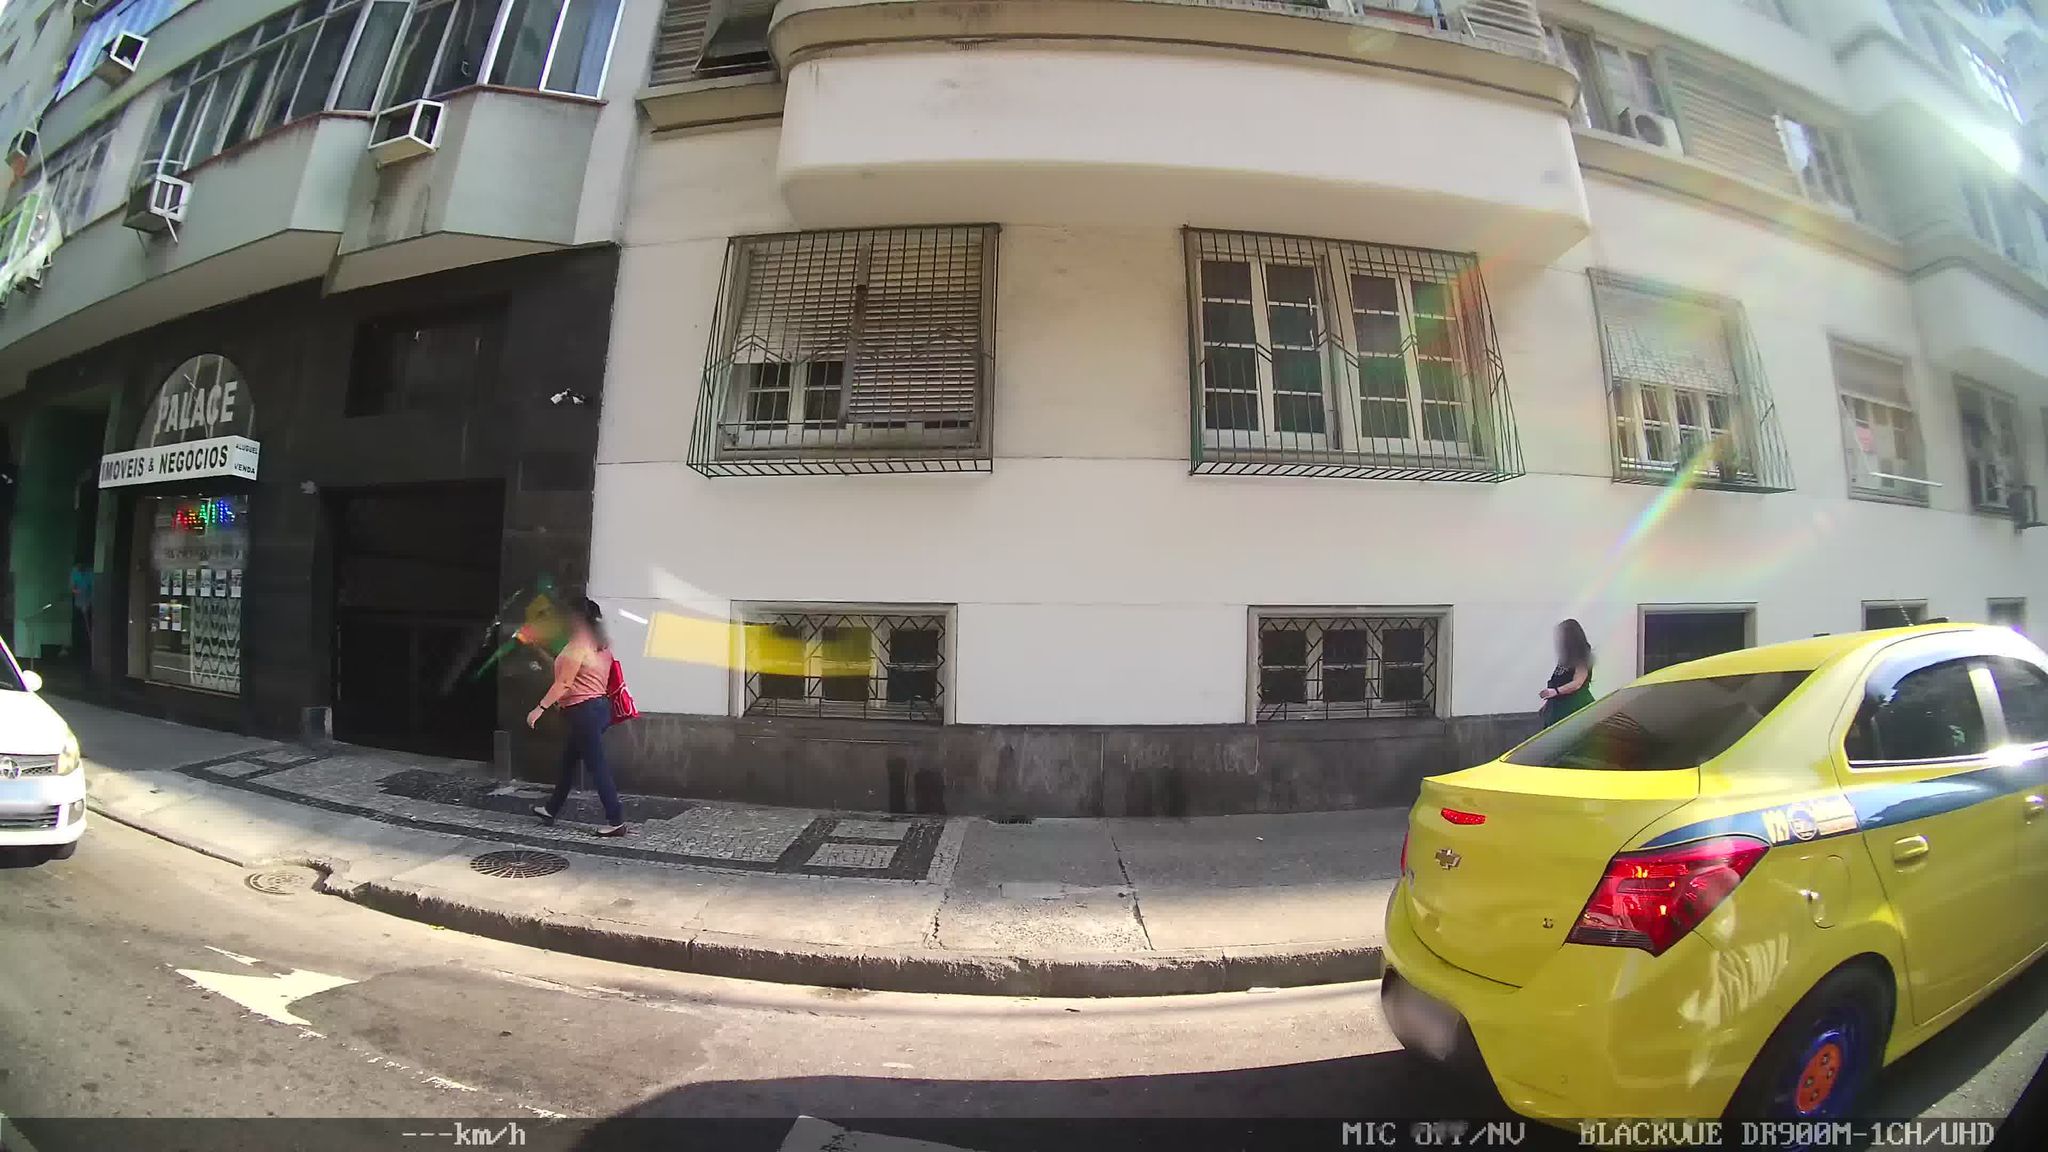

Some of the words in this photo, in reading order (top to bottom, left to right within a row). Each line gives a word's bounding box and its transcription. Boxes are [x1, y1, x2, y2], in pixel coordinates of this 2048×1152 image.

[154, 381, 238, 435] PALACE
[100, 457, 145, 482] IMOVEIS
[148, 458, 154, 472] &
[159, 445, 228, 474] NEGOCIOS
[234, 463, 256, 474] VENDA
